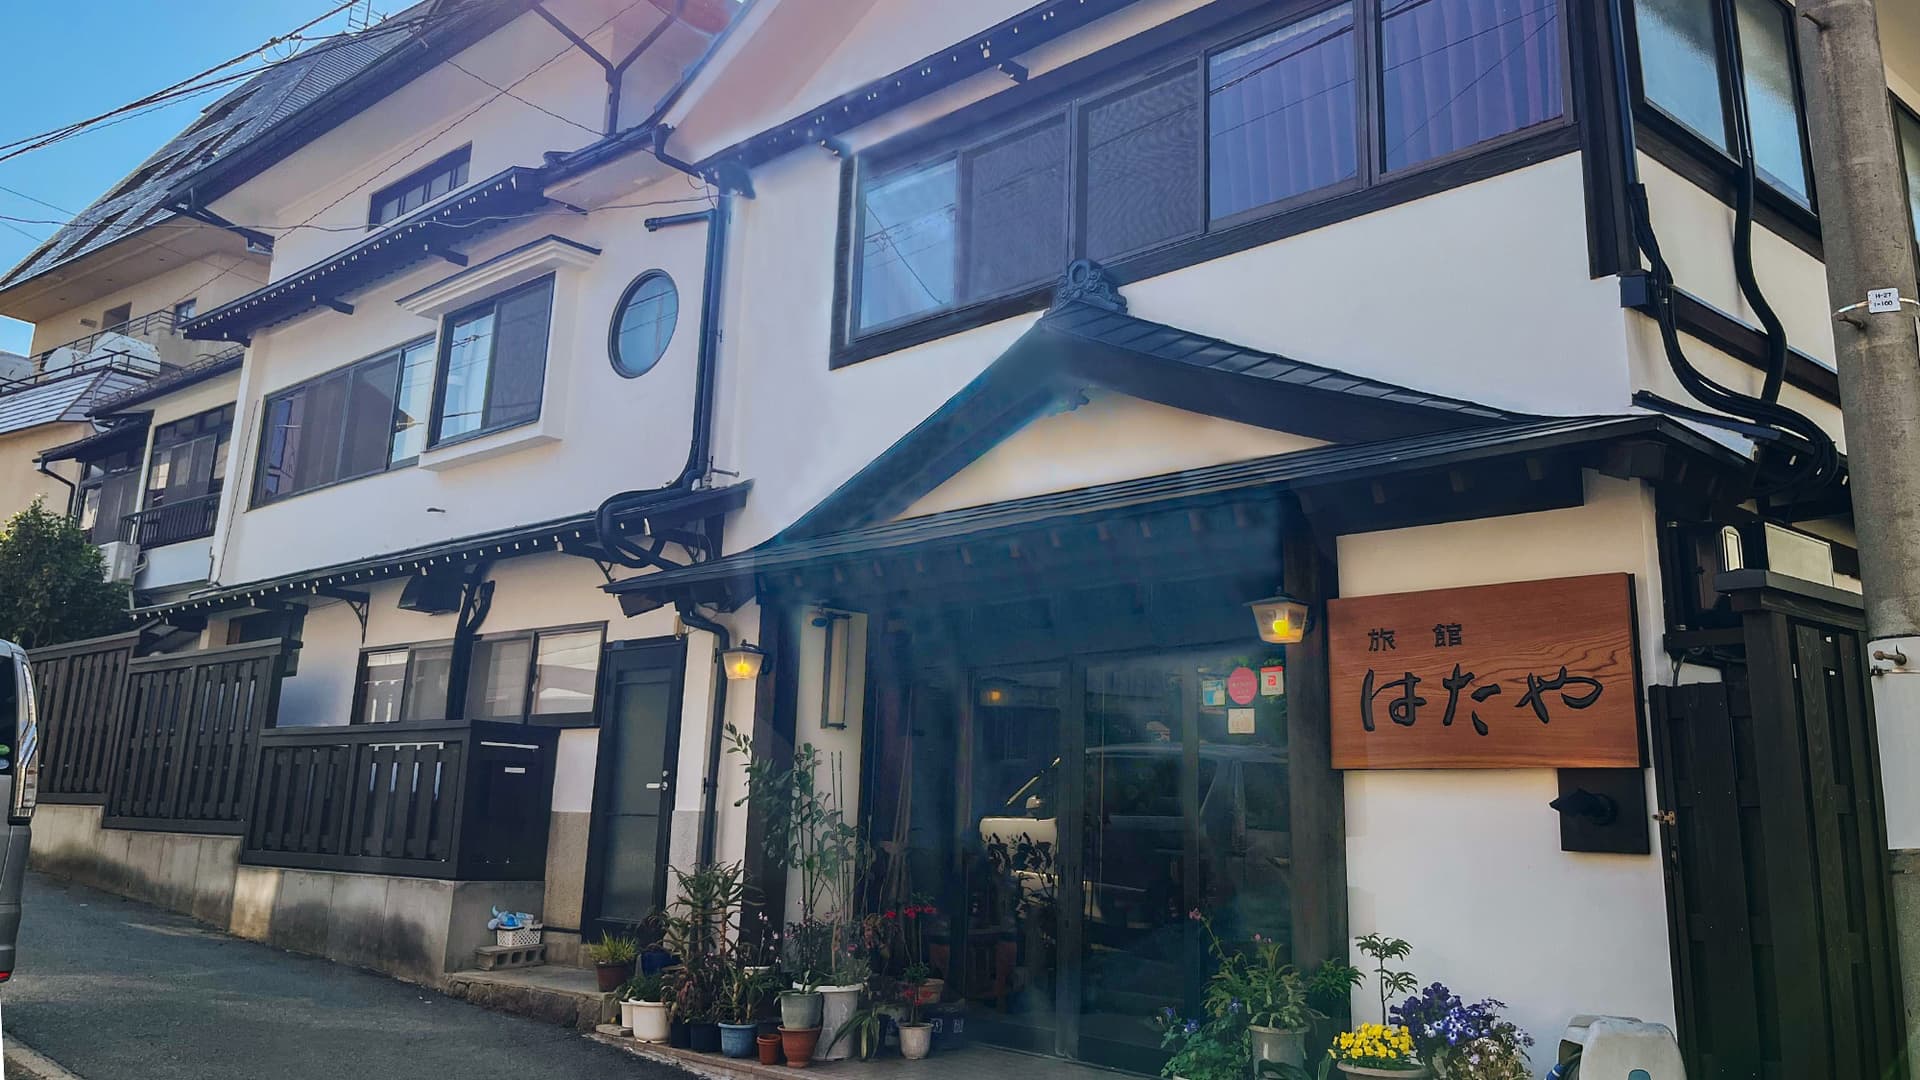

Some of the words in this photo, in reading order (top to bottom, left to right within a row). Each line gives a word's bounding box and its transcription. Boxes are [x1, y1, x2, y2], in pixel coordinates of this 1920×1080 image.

[1367, 622, 1463, 652] 旅館
[1360, 663, 1604, 736] はたや
